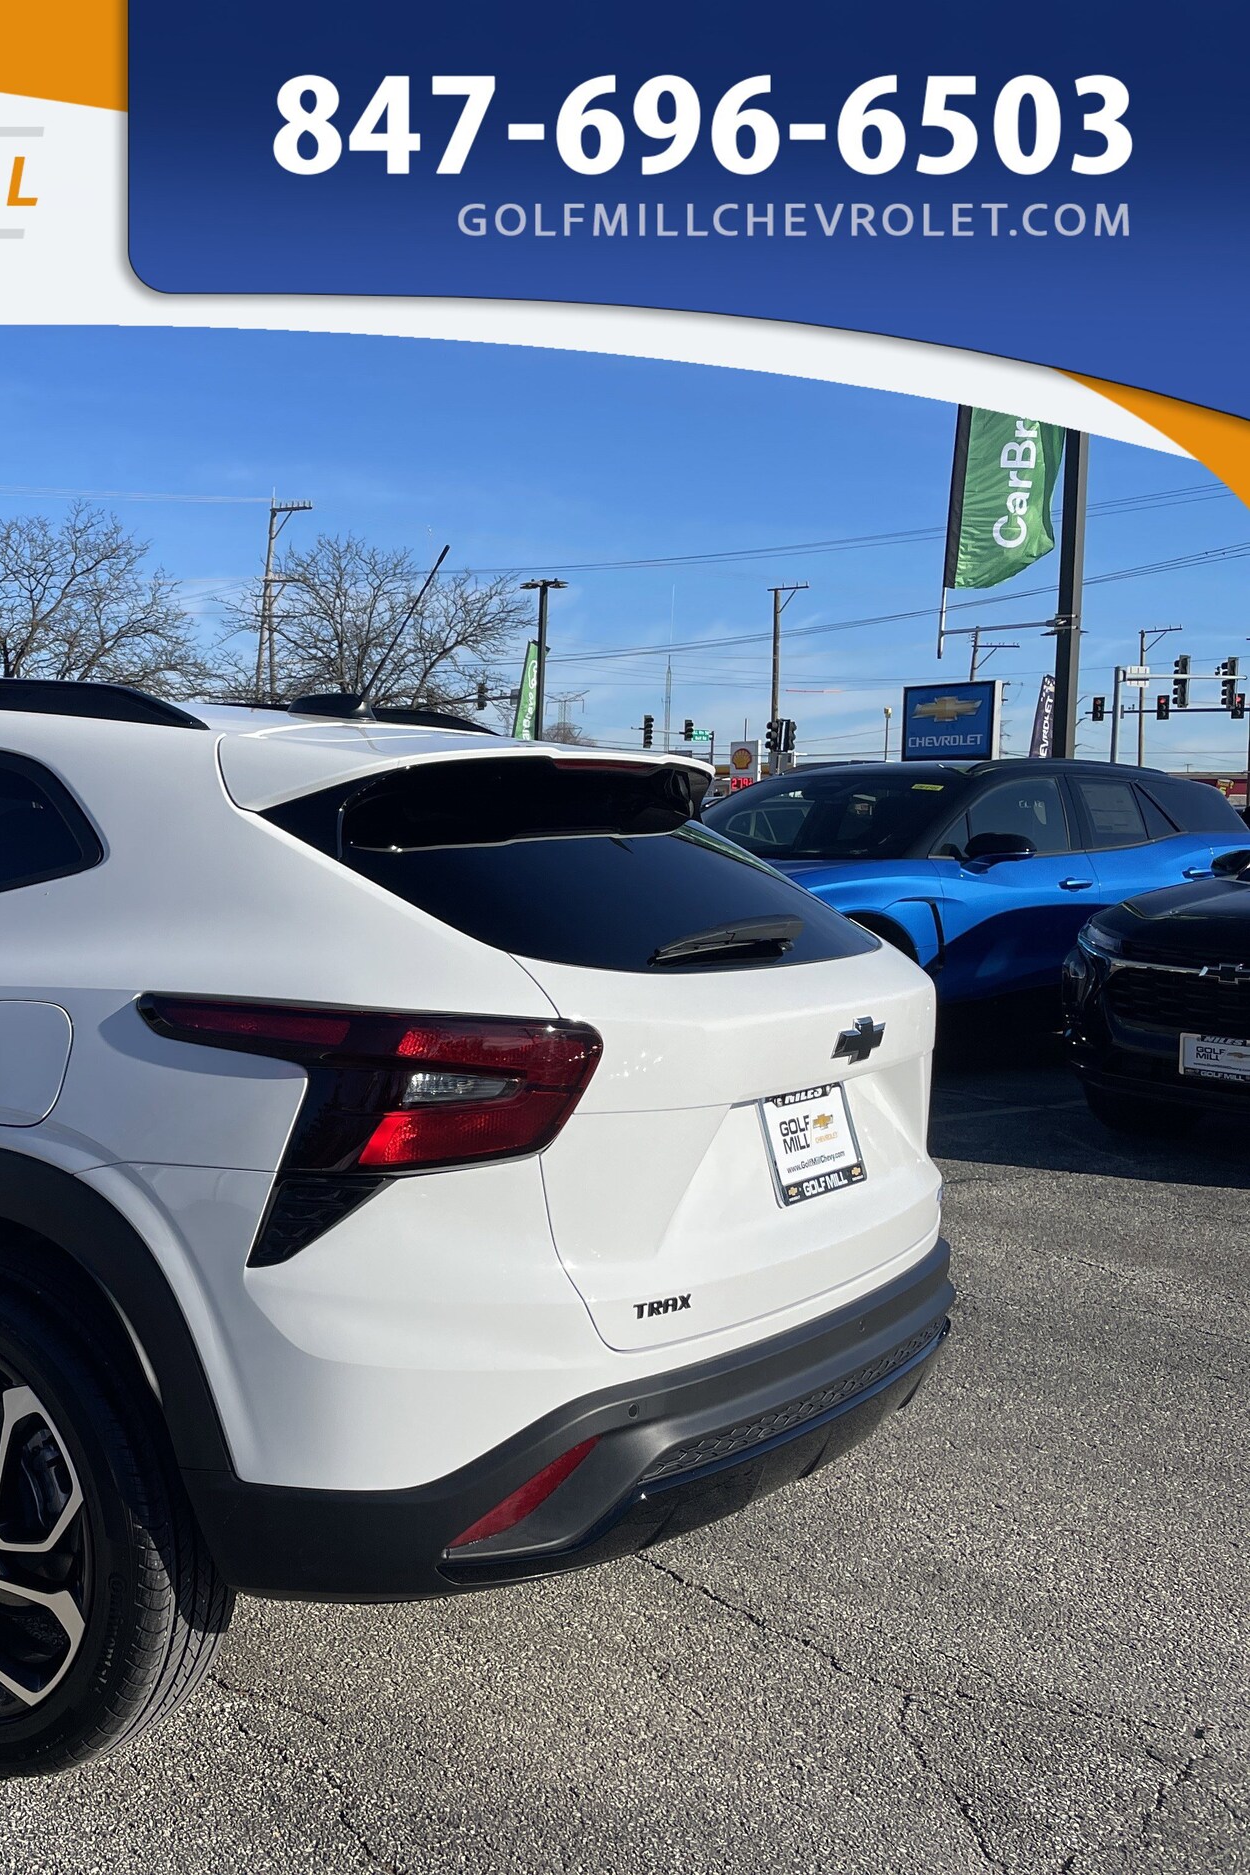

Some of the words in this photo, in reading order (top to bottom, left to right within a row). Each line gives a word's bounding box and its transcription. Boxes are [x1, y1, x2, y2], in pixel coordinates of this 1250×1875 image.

[992, 420, 1038, 548] CarBr
[522, 692, 535, 740] arBravo
[1039, 698, 1053, 758] EVROLET
[908, 734, 984, 748] CHEVROLET
[1196, 1046, 1226, 1055] GOLF
[1196, 1052, 1220, 1061] MILL
[779, 1114, 810, 1137] GOLF
[783, 1133, 810, 1154] MILL
[803, 1177, 825, 1197] GOLF
[824, 1171, 848, 1190] MILL
[633, 1293, 692, 1319] TRAX
